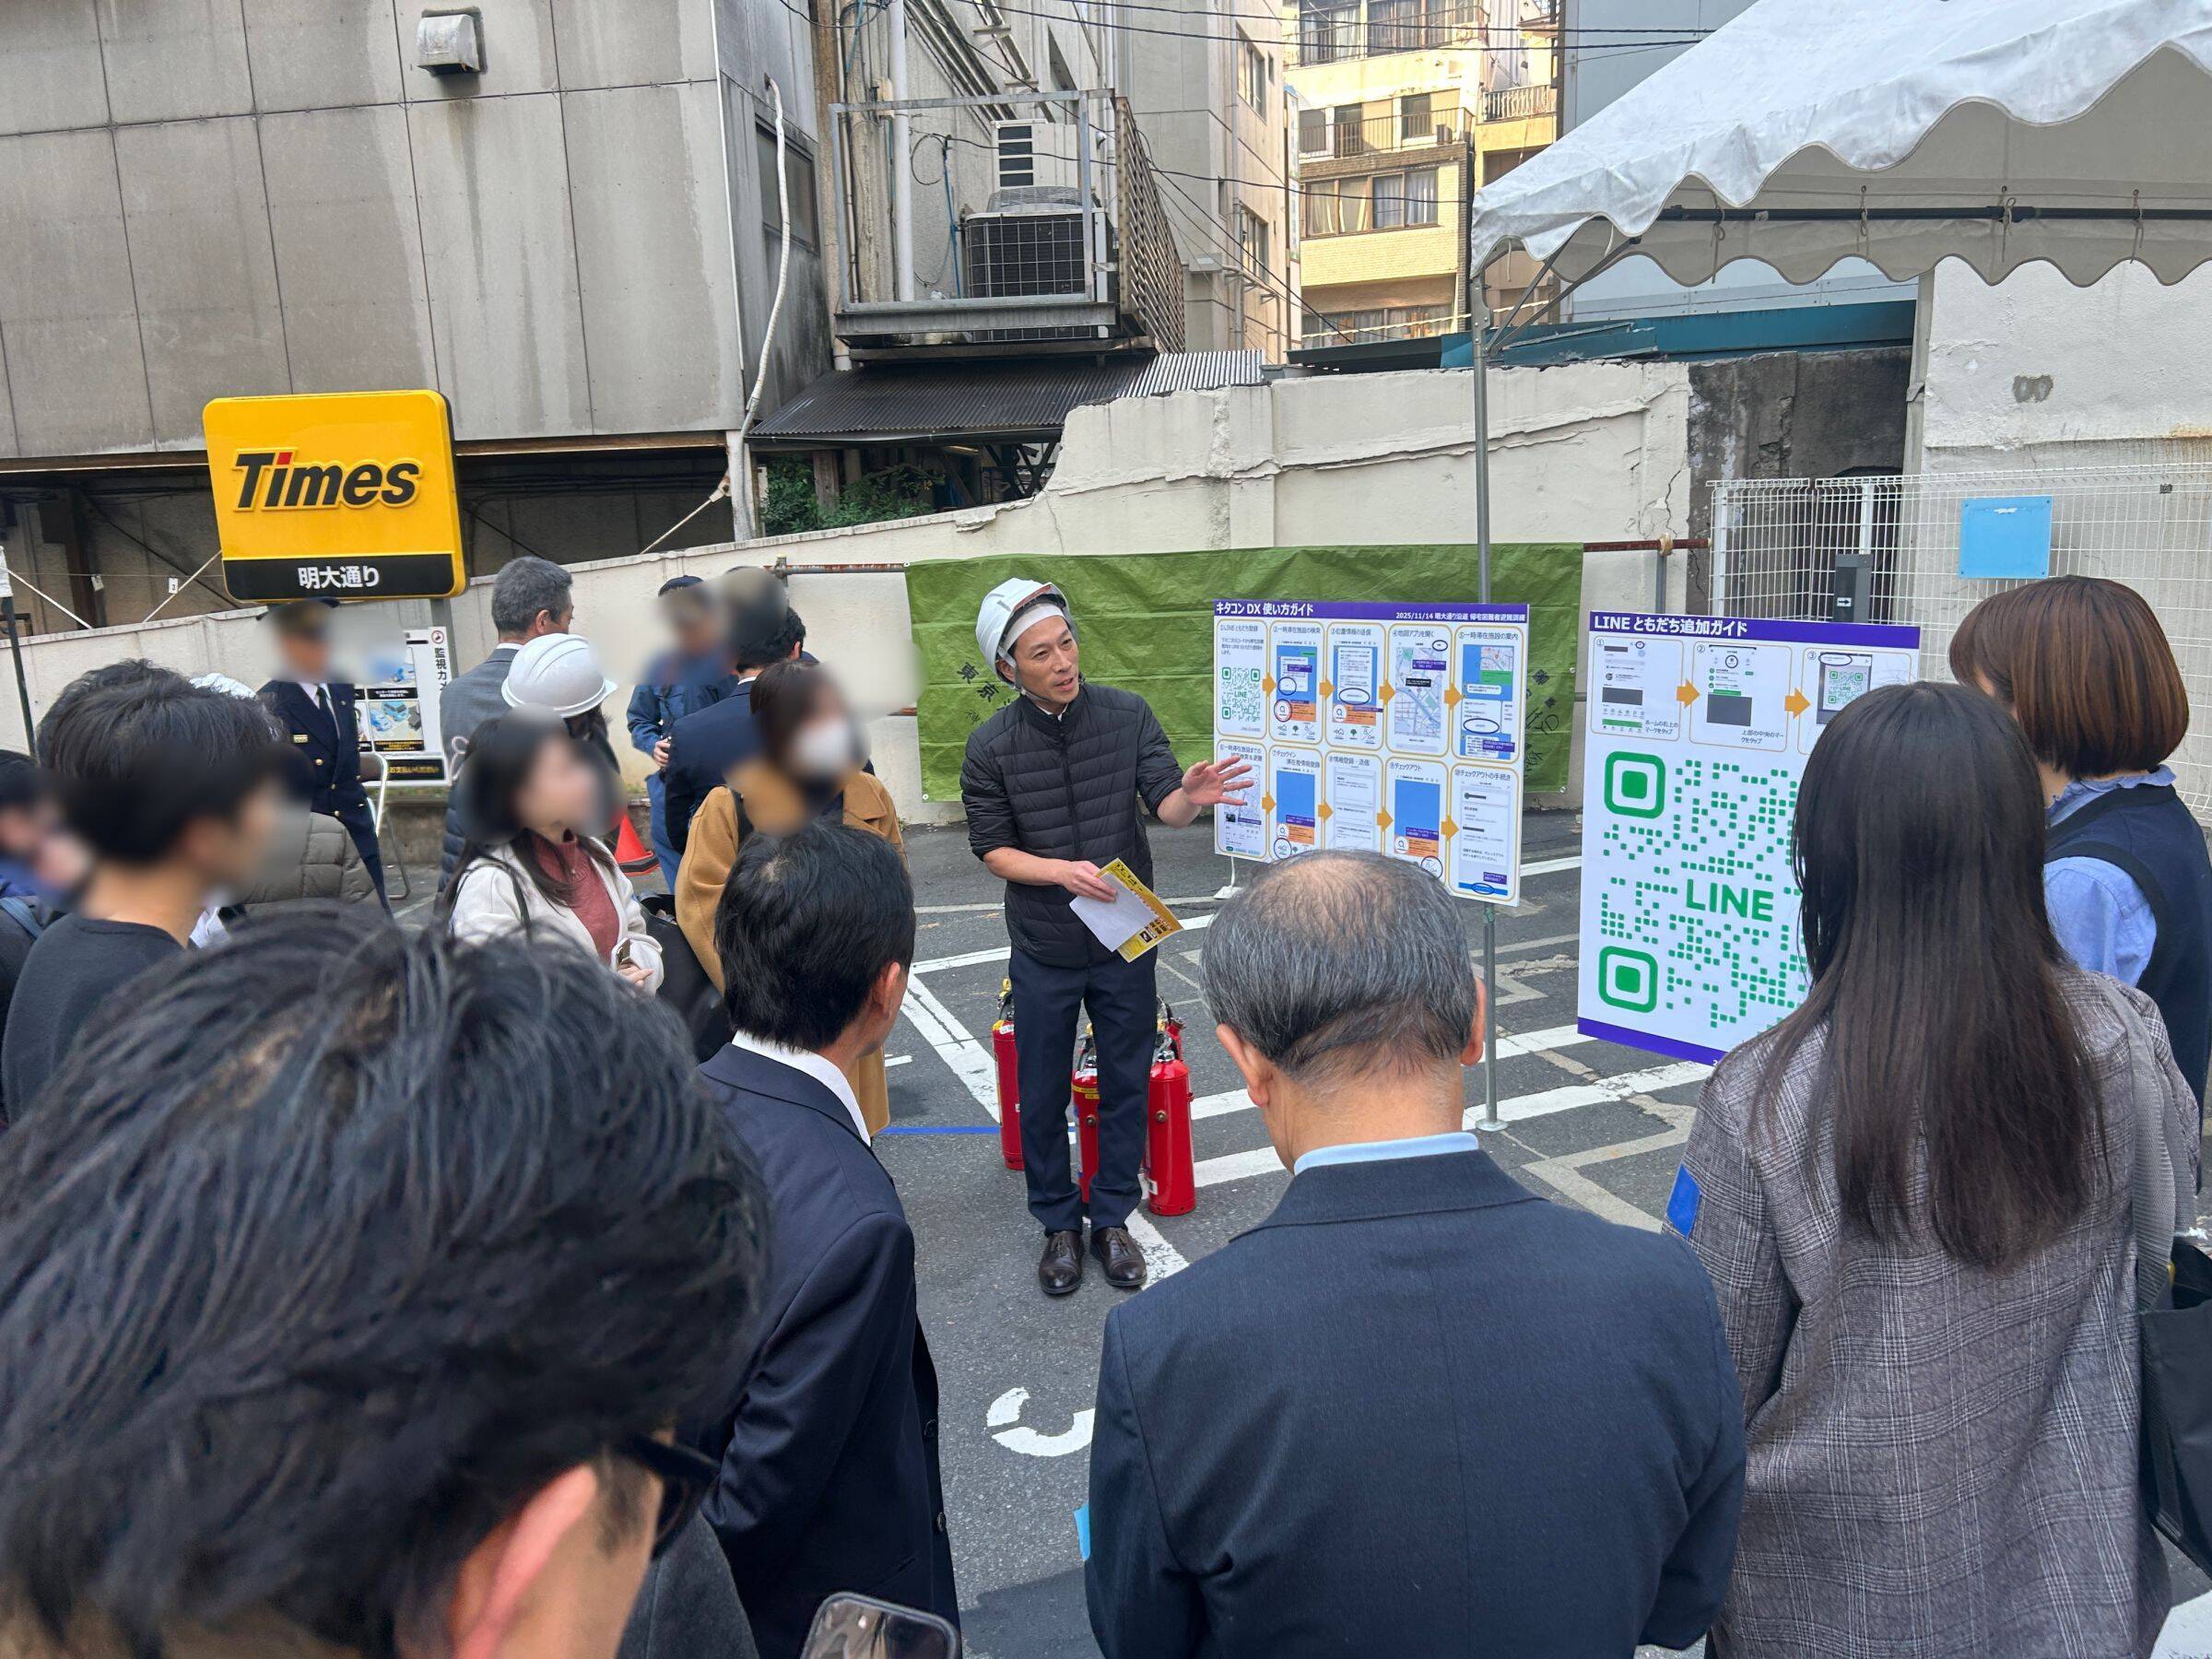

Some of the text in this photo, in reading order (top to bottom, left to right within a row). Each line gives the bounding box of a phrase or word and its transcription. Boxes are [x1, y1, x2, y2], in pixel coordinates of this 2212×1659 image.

[235, 450, 421, 510] Times
[298, 565, 380, 590] 明大通り
[1216, 601, 1314, 617] キタコン DX 使い方ガイド
[1395, 612, 1433, 620] 2025/11/14
[1594, 616, 1747, 637] LINE ともだち追加ガイド
[1686, 878, 1774, 923] LINE
